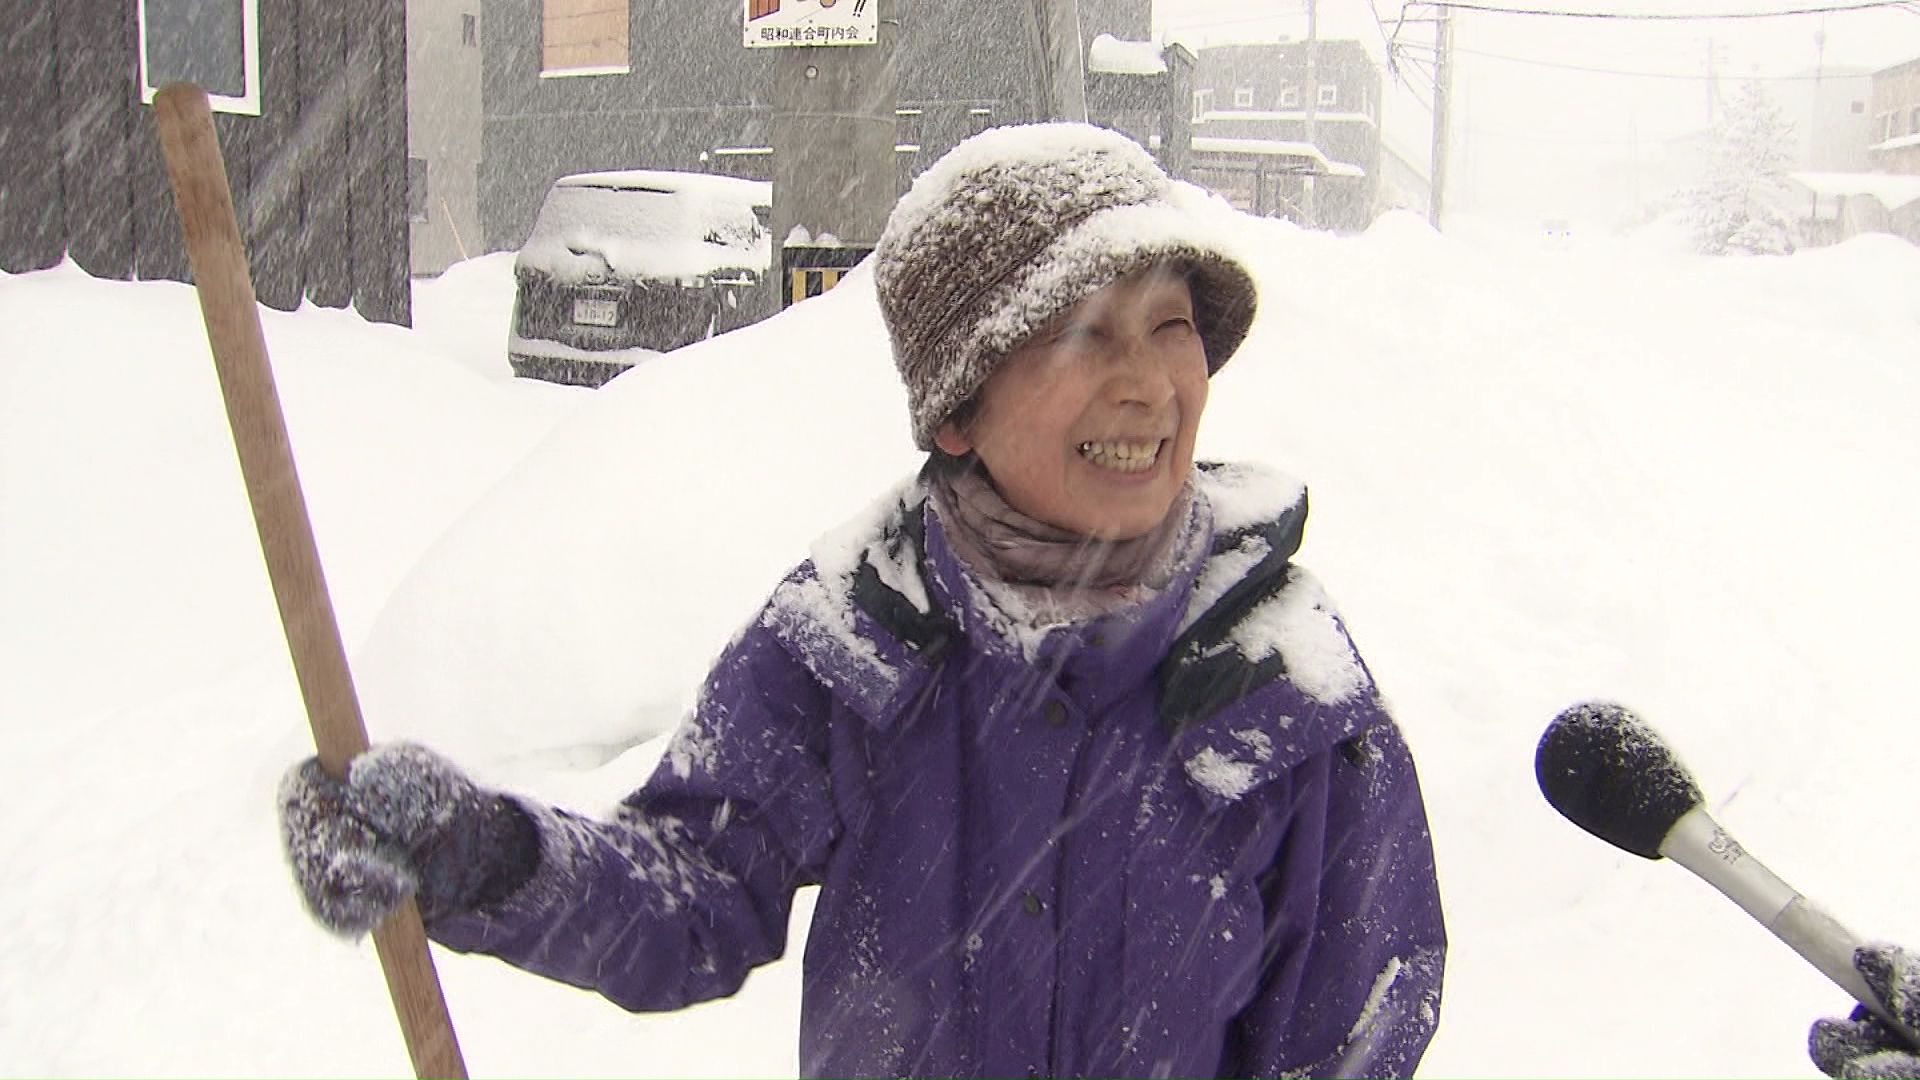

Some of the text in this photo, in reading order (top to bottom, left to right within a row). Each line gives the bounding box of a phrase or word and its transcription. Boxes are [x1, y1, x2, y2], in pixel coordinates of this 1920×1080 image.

[760, 25, 859, 41] 昭和連合町内会
